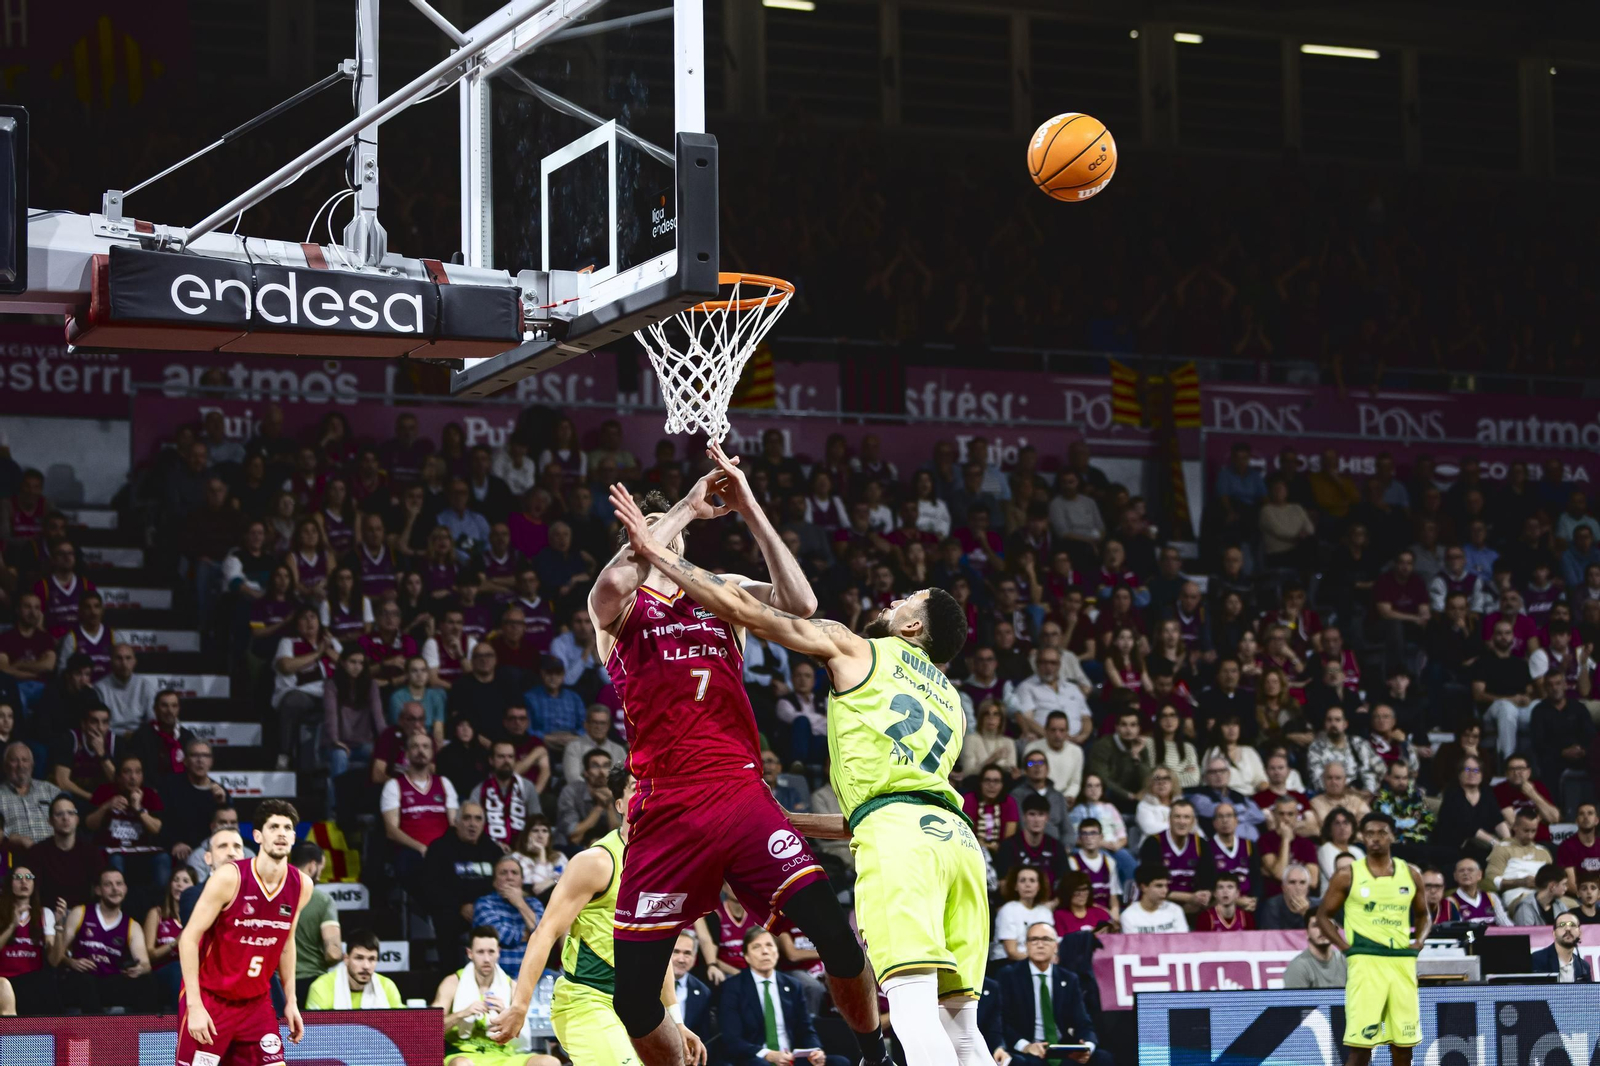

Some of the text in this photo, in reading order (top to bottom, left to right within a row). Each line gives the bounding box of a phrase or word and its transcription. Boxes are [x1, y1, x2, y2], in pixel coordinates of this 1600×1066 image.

[1088, 154, 1107, 171] acb
[651, 207, 665, 224] liga
[170, 271, 424, 334] endesa
[163, 362, 359, 405] artmos
[1212, 397, 1304, 434] PONS
[1357, 403, 1446, 442] PONS
[690, 668, 712, 702] 7
[901, 650, 948, 690] DUARTE
[884, 694, 954, 774] 27
[220, 775, 248, 789] Pujol
[246, 955, 265, 978] 5
